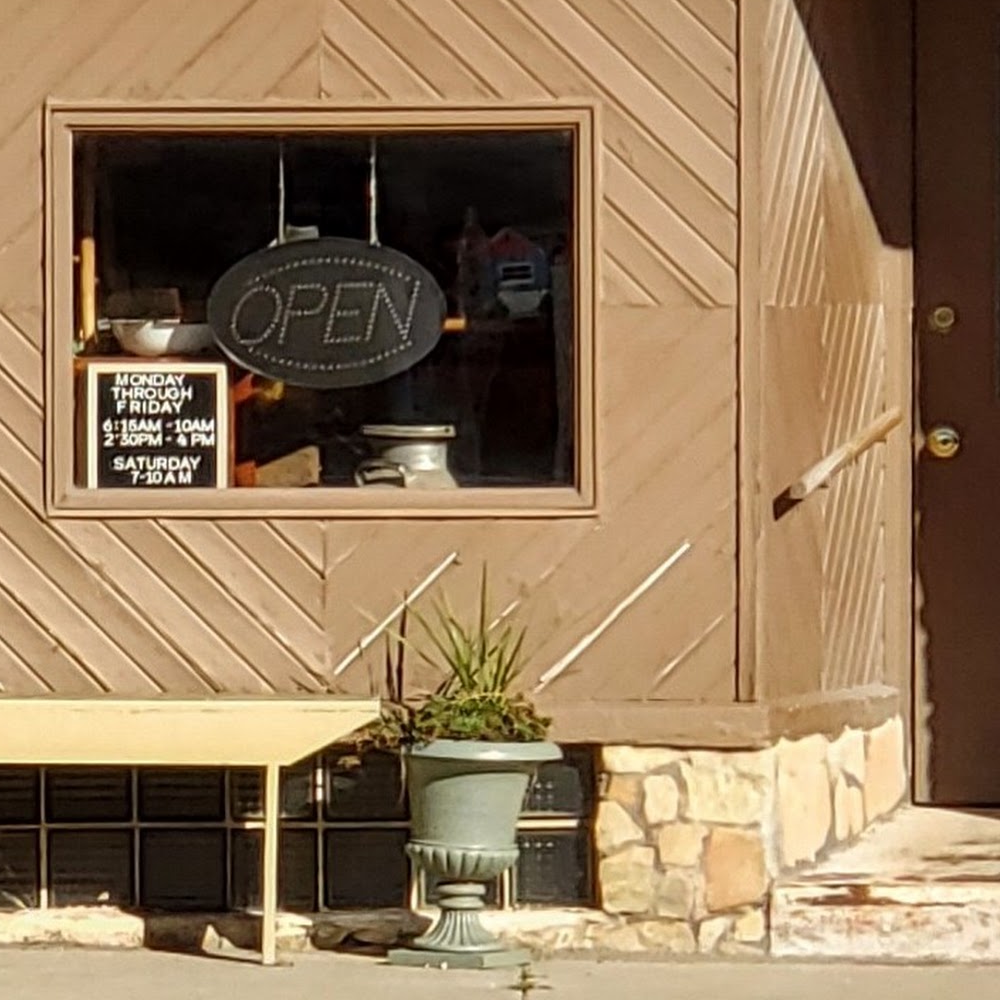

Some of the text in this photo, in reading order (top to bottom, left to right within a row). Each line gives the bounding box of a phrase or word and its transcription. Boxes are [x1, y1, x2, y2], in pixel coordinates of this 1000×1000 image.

[230, 279, 421, 346] OPEN
[115, 374, 185, 386] MONDAY
[111, 386, 193, 400] THROUGH
[116, 400, 184, 414] FRIDAY
[113, 456, 201, 471] SATURDAY
